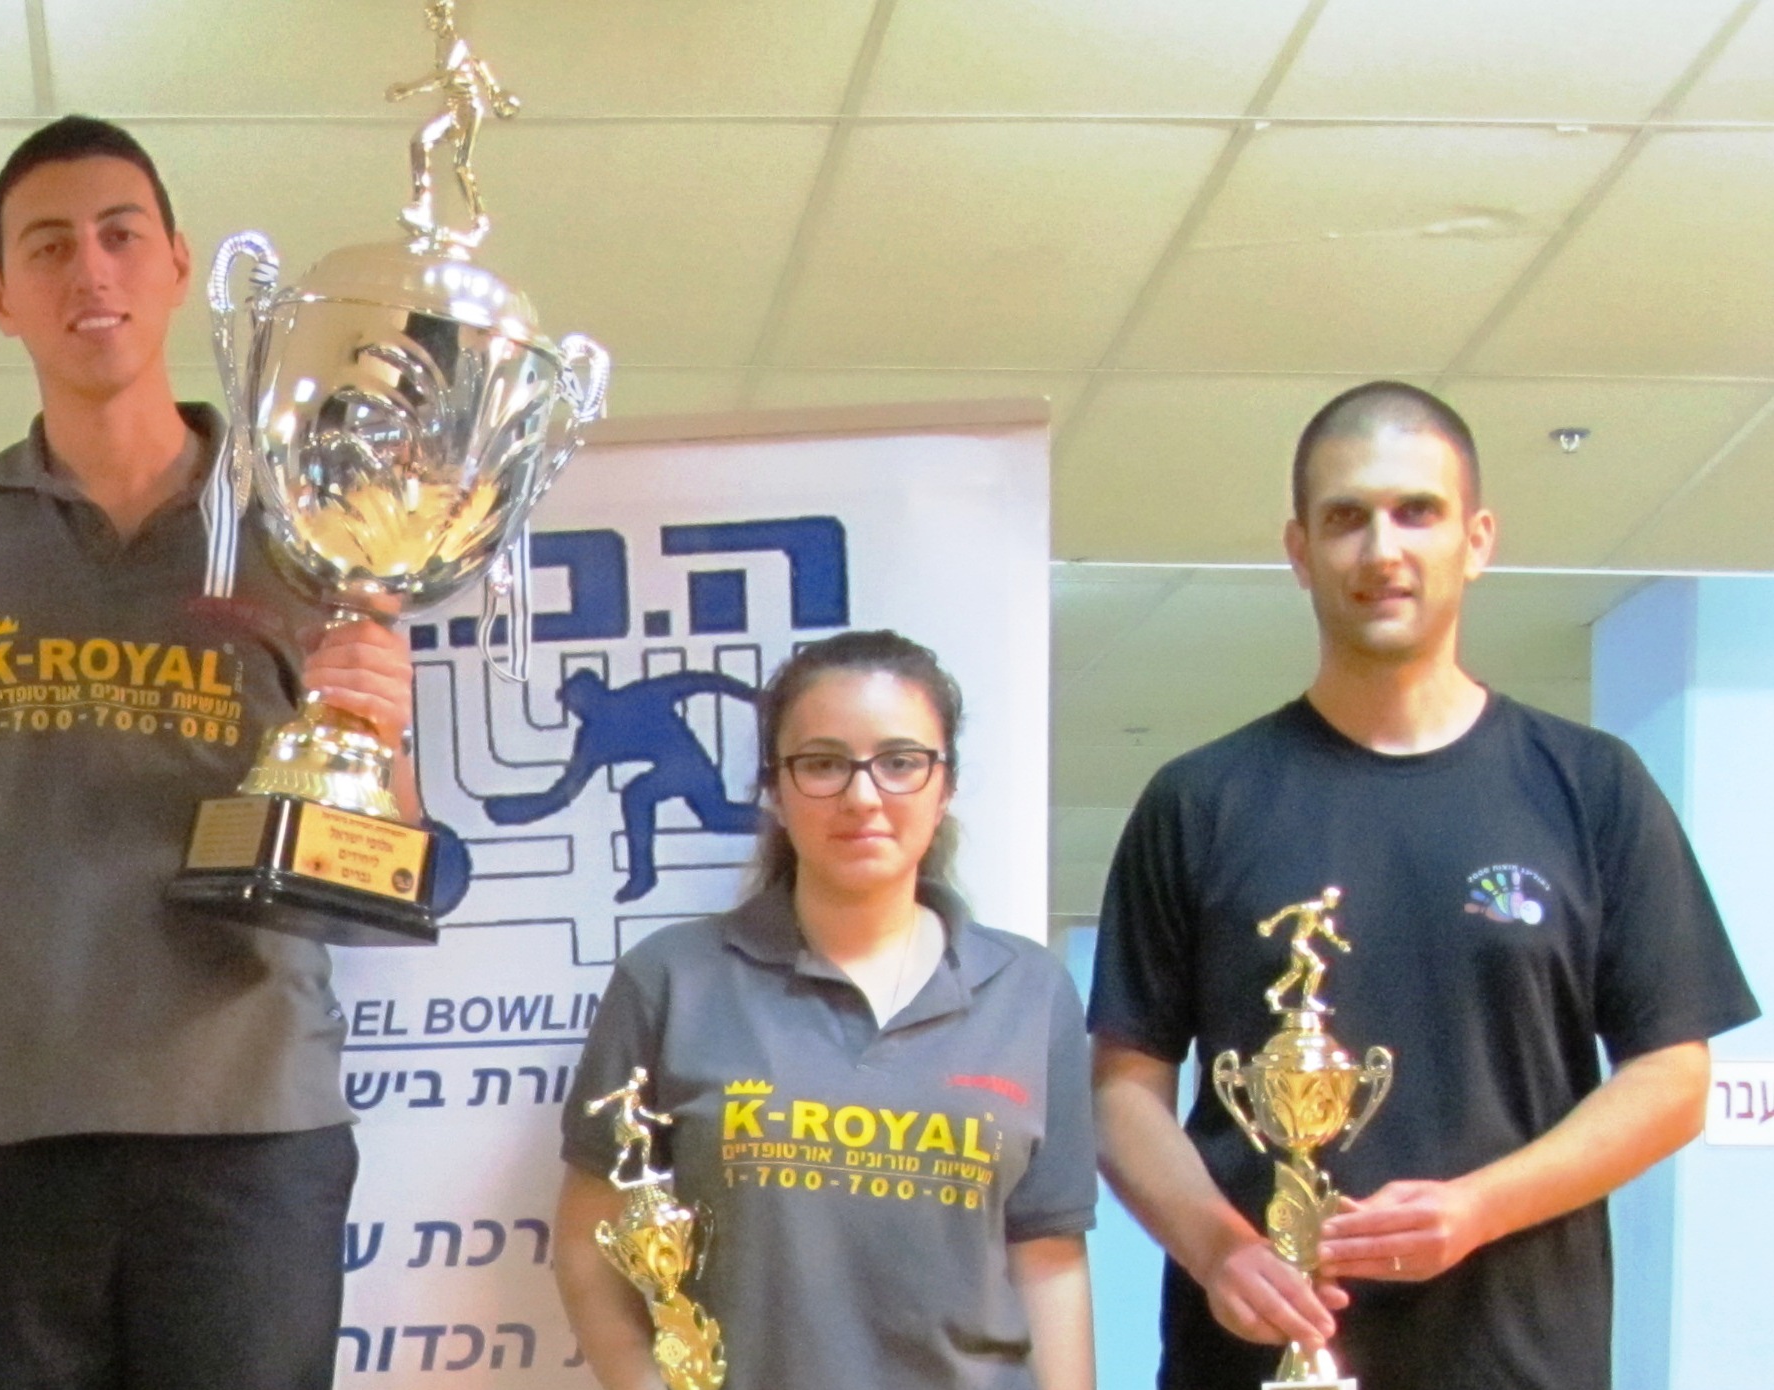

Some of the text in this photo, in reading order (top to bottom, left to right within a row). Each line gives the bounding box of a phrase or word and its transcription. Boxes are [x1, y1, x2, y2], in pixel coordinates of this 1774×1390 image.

[351, 1000, 408, 1036] EL
[345, 1065, 569, 1110] ורת ביש
[723, 1099, 991, 1163] K-ROYAL
[725, 1166, 986, 1209] 1-700-700-08
[406, 1218, 552, 1269] רכת
[336, 1323, 536, 1372] הכדור
